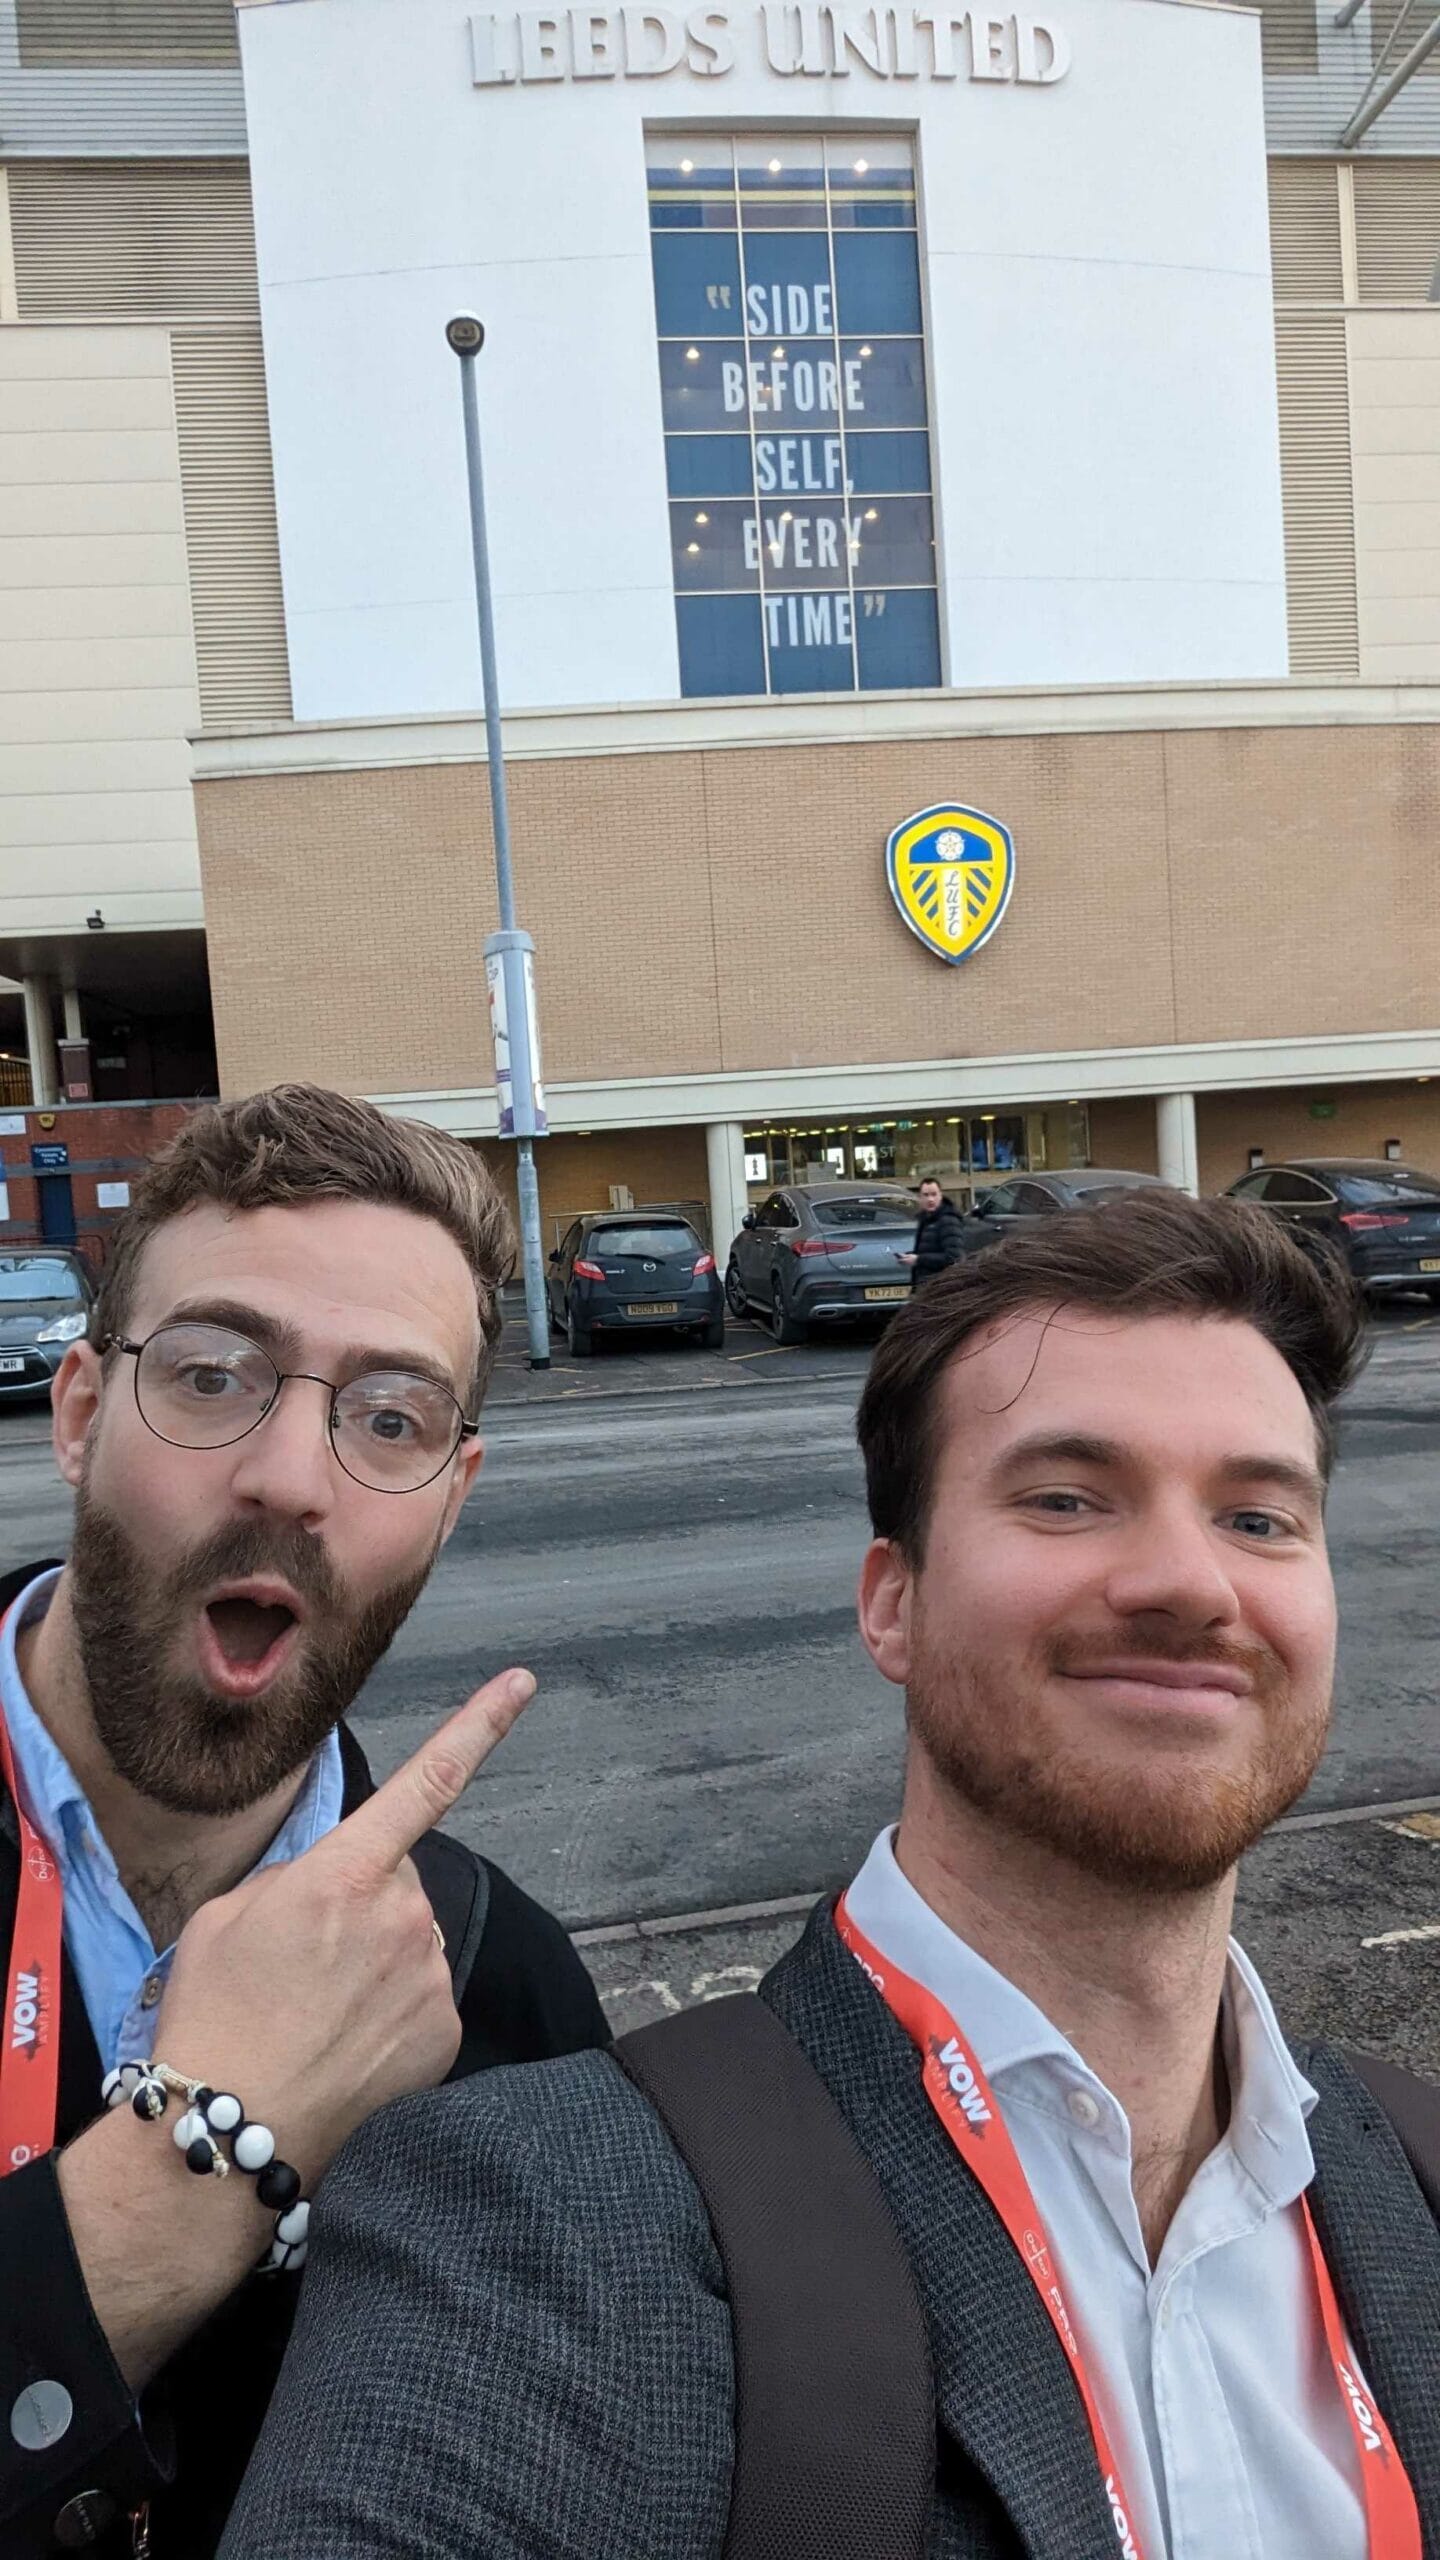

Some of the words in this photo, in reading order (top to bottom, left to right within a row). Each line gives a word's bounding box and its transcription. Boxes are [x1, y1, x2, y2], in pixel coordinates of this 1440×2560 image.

[466, 7, 734, 88] LEEDS
[760, 4, 1073, 85] UNITED
[722, 360, 865, 412] BEFORE
[742, 516, 863, 570] EVERY
[11, 1971, 38, 2050] VOW
[939, 2036, 992, 2122] VOW
[1337, 2363, 1382, 2452] VOW
